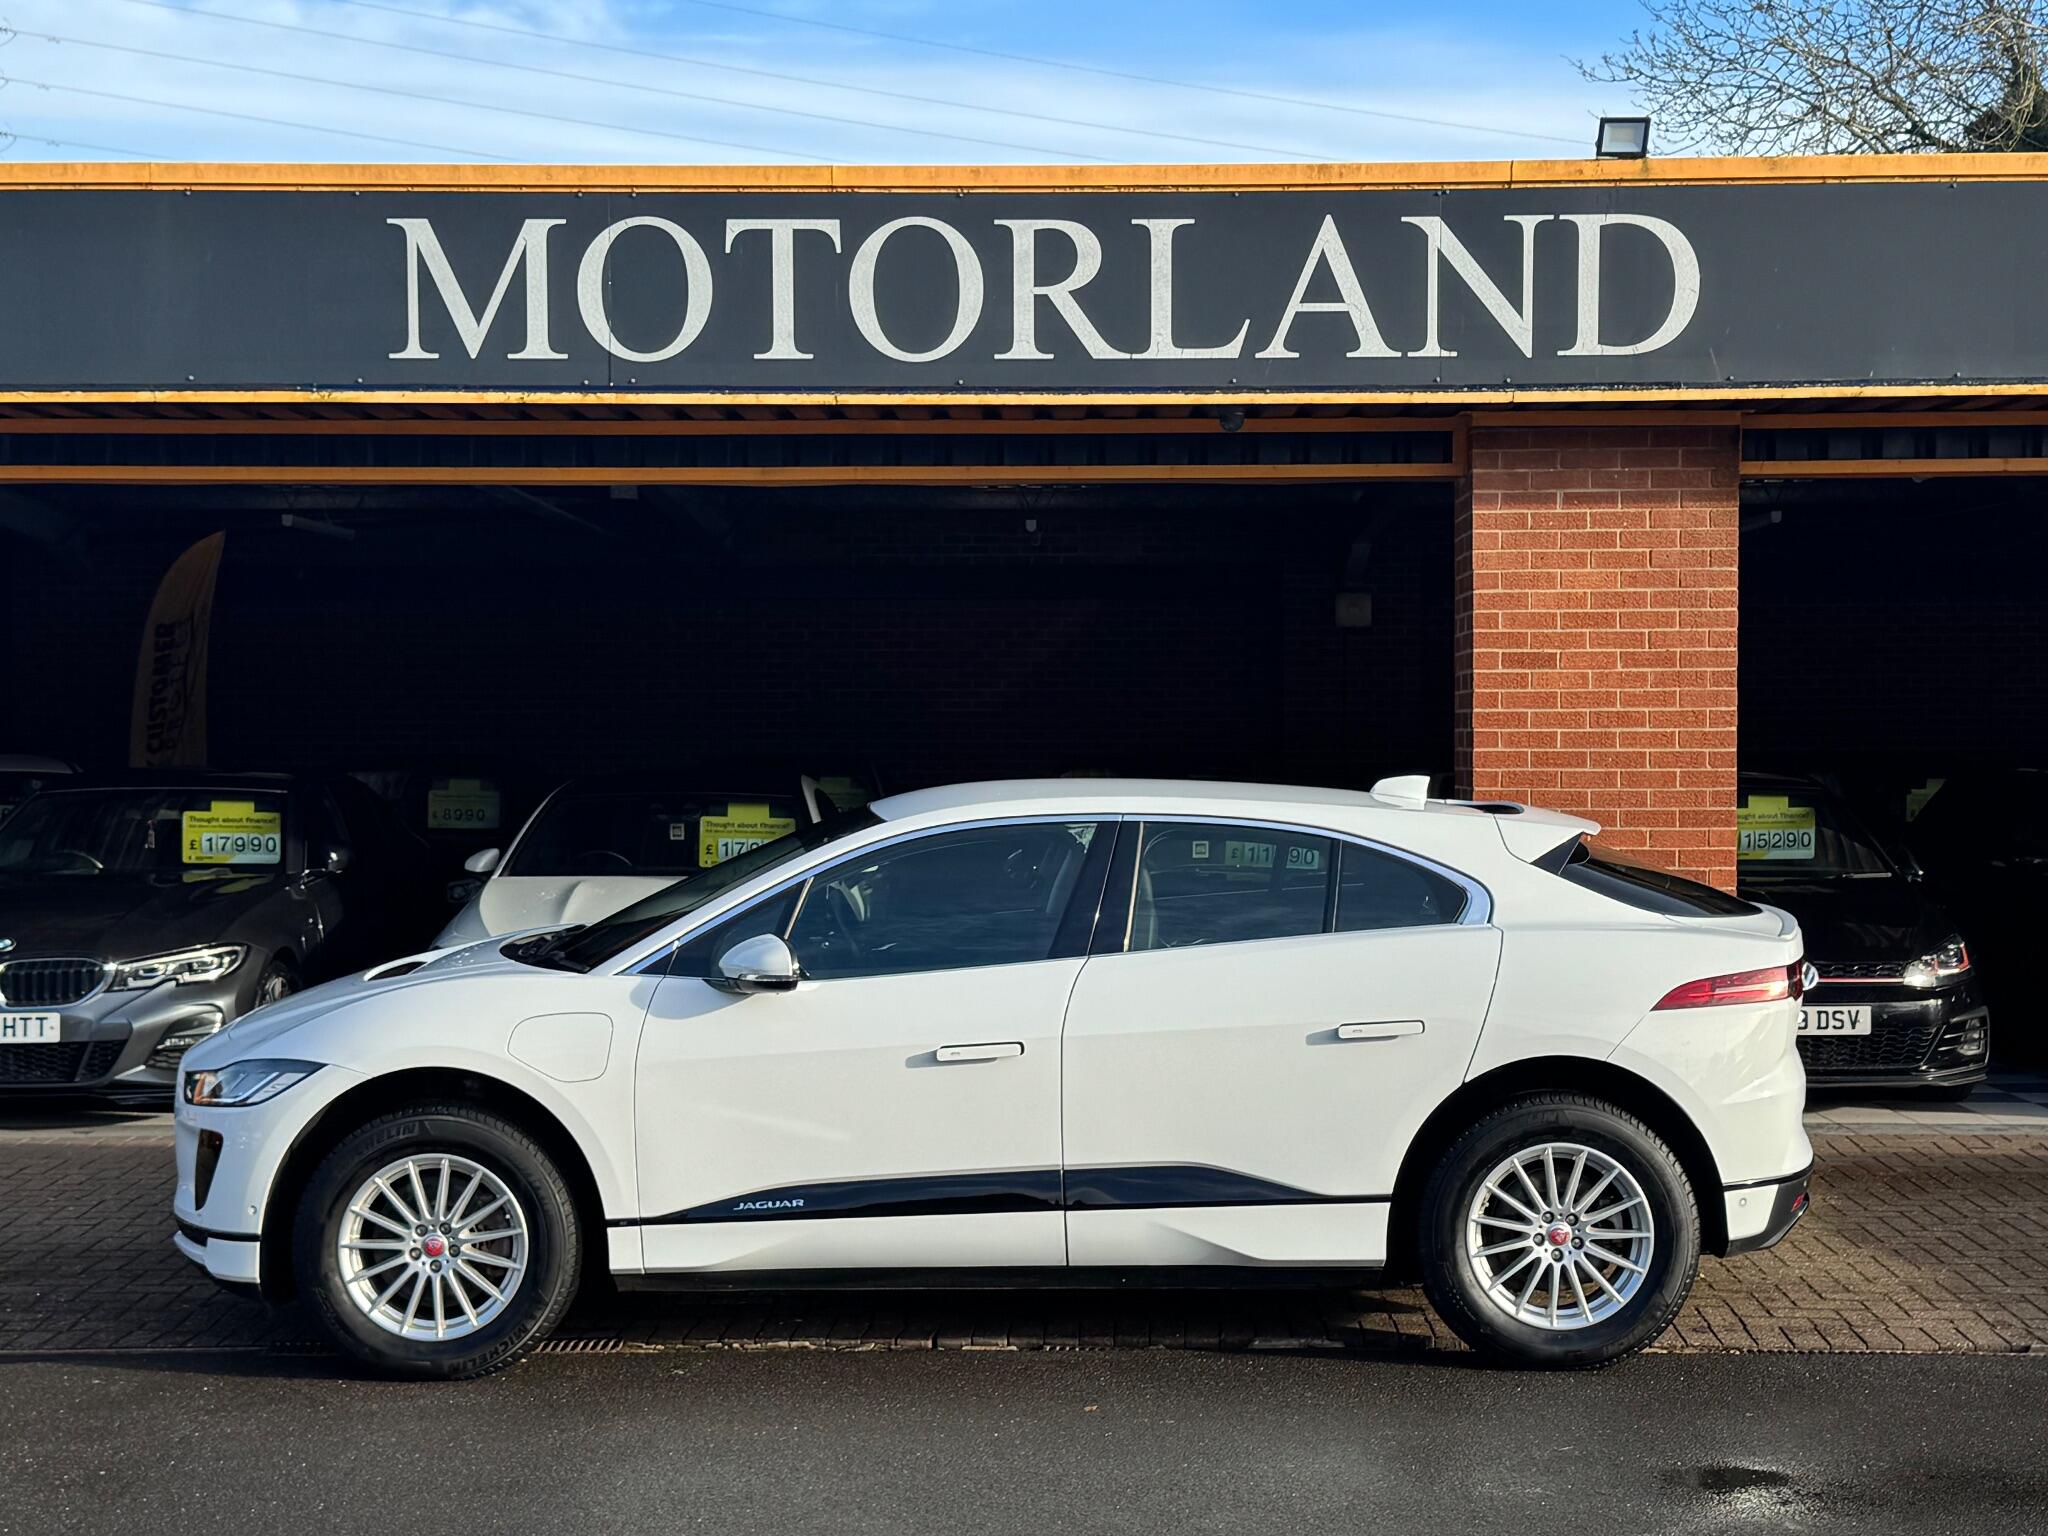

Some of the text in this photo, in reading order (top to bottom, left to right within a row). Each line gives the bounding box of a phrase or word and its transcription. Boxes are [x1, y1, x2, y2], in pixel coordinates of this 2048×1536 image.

[386, 213, 1702, 364] MOTORLAND
[189, 815, 217, 824] Thought
[443, 808, 485, 821] 8990
[189, 836, 277, 852] £ 17990
[1744, 832, 1811, 849] 15290
[705, 844, 713, 855] £
[1231, 848, 1238, 858] £
[3, 1016, 48, 1038] HTT
[1816, 1009, 1860, 1030] DSV
[732, 1198, 805, 1211] JAGUAR
[447, 1323, 528, 1374] MICHELIN
